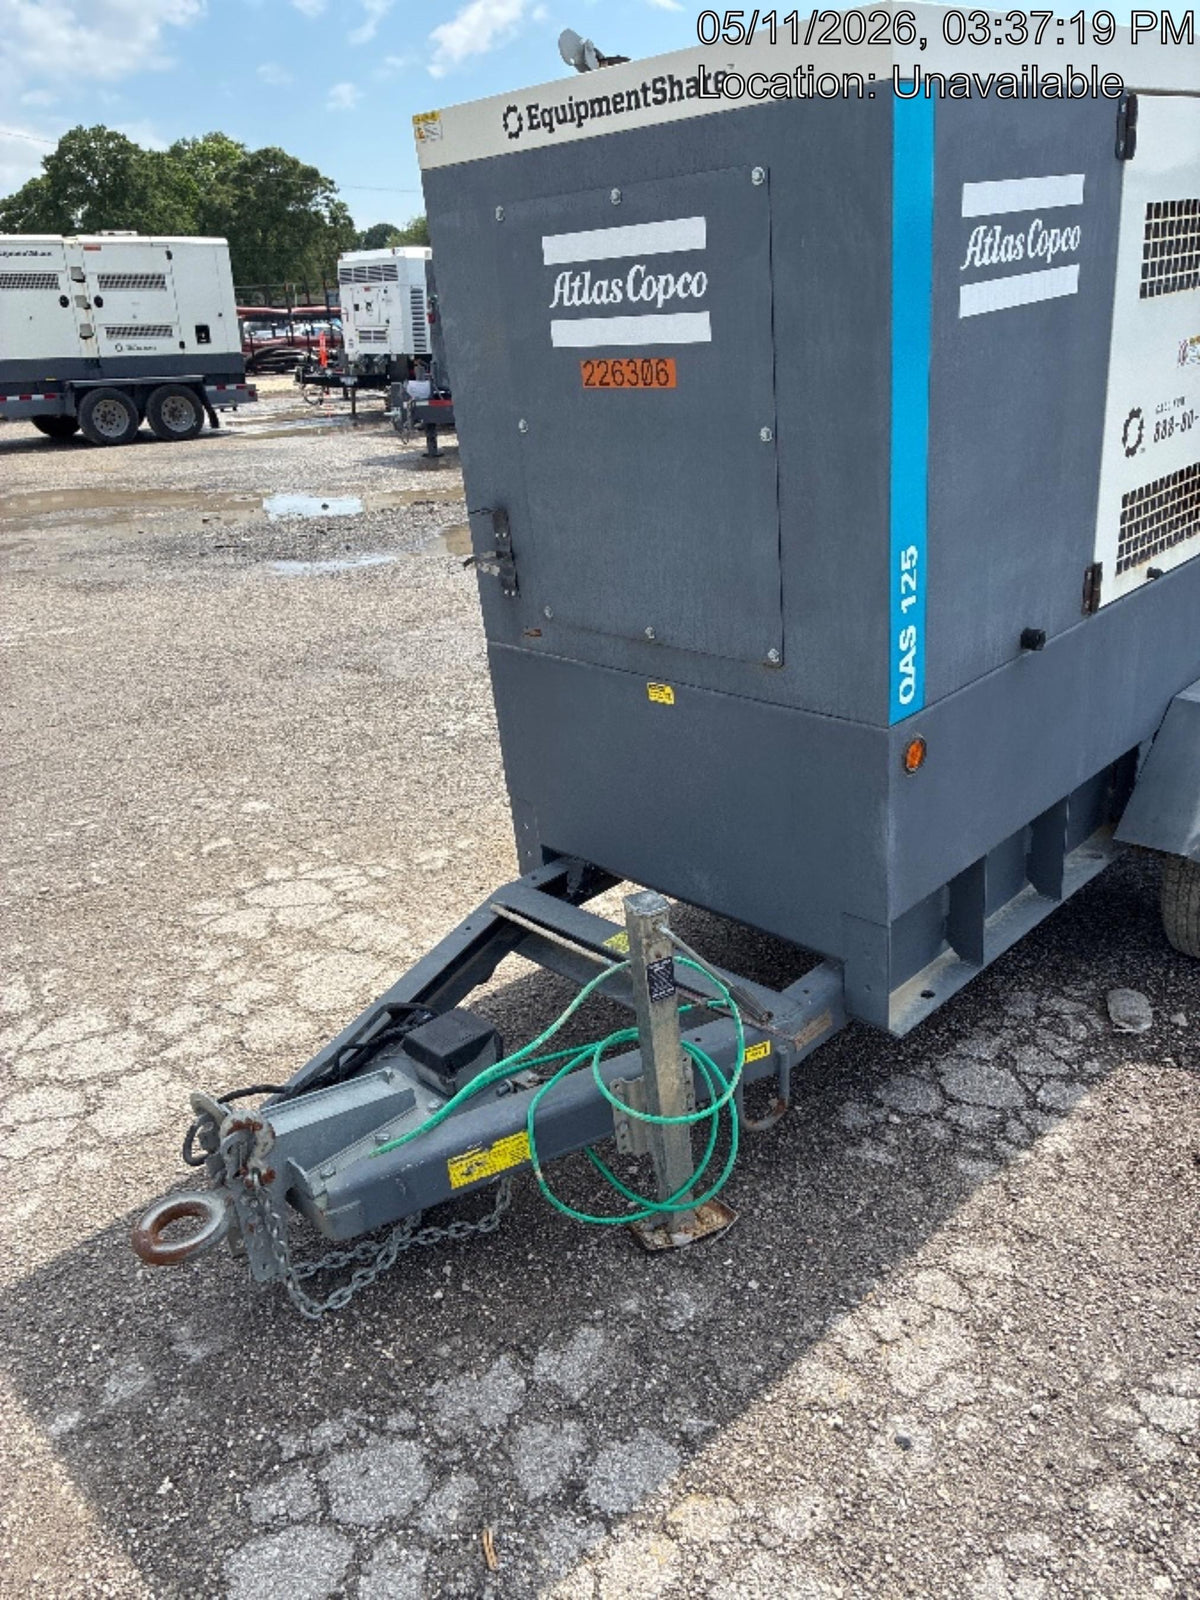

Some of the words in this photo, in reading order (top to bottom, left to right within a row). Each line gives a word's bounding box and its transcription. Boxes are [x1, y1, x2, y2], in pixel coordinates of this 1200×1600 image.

[960, 225, 1025, 271] Atlas
[1027, 218, 1081, 264] Copco
[549, 270, 623, 308] Atlas
[626, 264, 708, 308] Copco
[583, 358, 670, 387] 226306
[901, 545, 918, 614] 125
